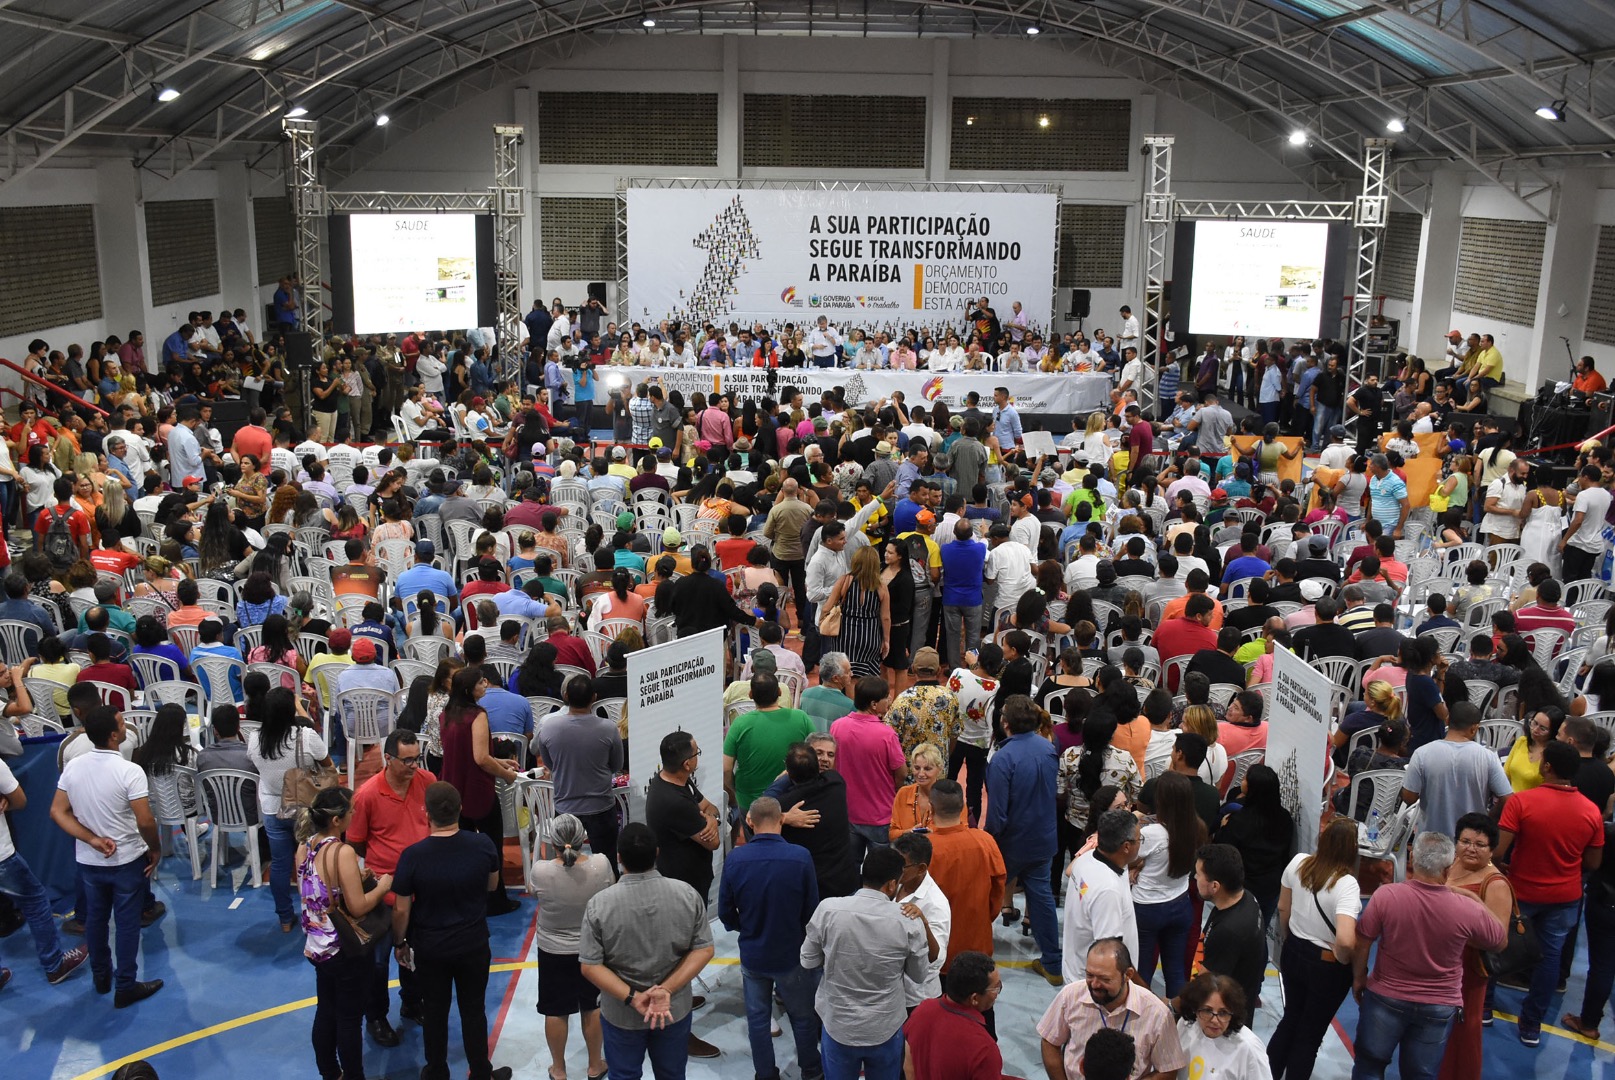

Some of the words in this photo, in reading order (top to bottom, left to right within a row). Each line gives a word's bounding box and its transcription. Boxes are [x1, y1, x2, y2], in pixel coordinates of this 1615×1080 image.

[810, 216, 821, 234] A
[828, 215, 860, 234] SUA
[867, 213, 990, 240] PARTICIPAÇÃO
[809, 239, 862, 258] SEGUE
[870, 240, 1021, 260] TRANSFORMANDO
[809, 264, 820, 282] A
[828, 260, 902, 282] PARAÍBA
[926, 264, 998, 280] ORÇAMENTO
[925, 278, 1008, 294] DEMOCRÁTICO
[664, 372, 713, 383] ORÇAMENTO
[732, 374, 748, 382] SUA
[751, 374, 808, 384] PARIPAÇÃO
[724, 384, 749, 393] SEGUE
[353, 626, 383, 634] England
[640, 675, 644, 685] A
[646, 670, 658, 683] SUA
[660, 656, 704, 679] PARTICIPAÇÃO
[640, 682, 660, 696] SEGUE
[662, 665, 715, 689] TRANSFORMANDO
[640, 699, 645, 708] A
[647, 688, 674, 706] PARAÍBA
[1276, 693, 1279, 701] A
[1278, 670, 1281, 680] A
[1290, 679, 1316, 706] PARTICIPAÇÃO
[1277, 681, 1289, 697] SEGUE
[1290, 690, 1322, 723] TRANSFORMANDO
